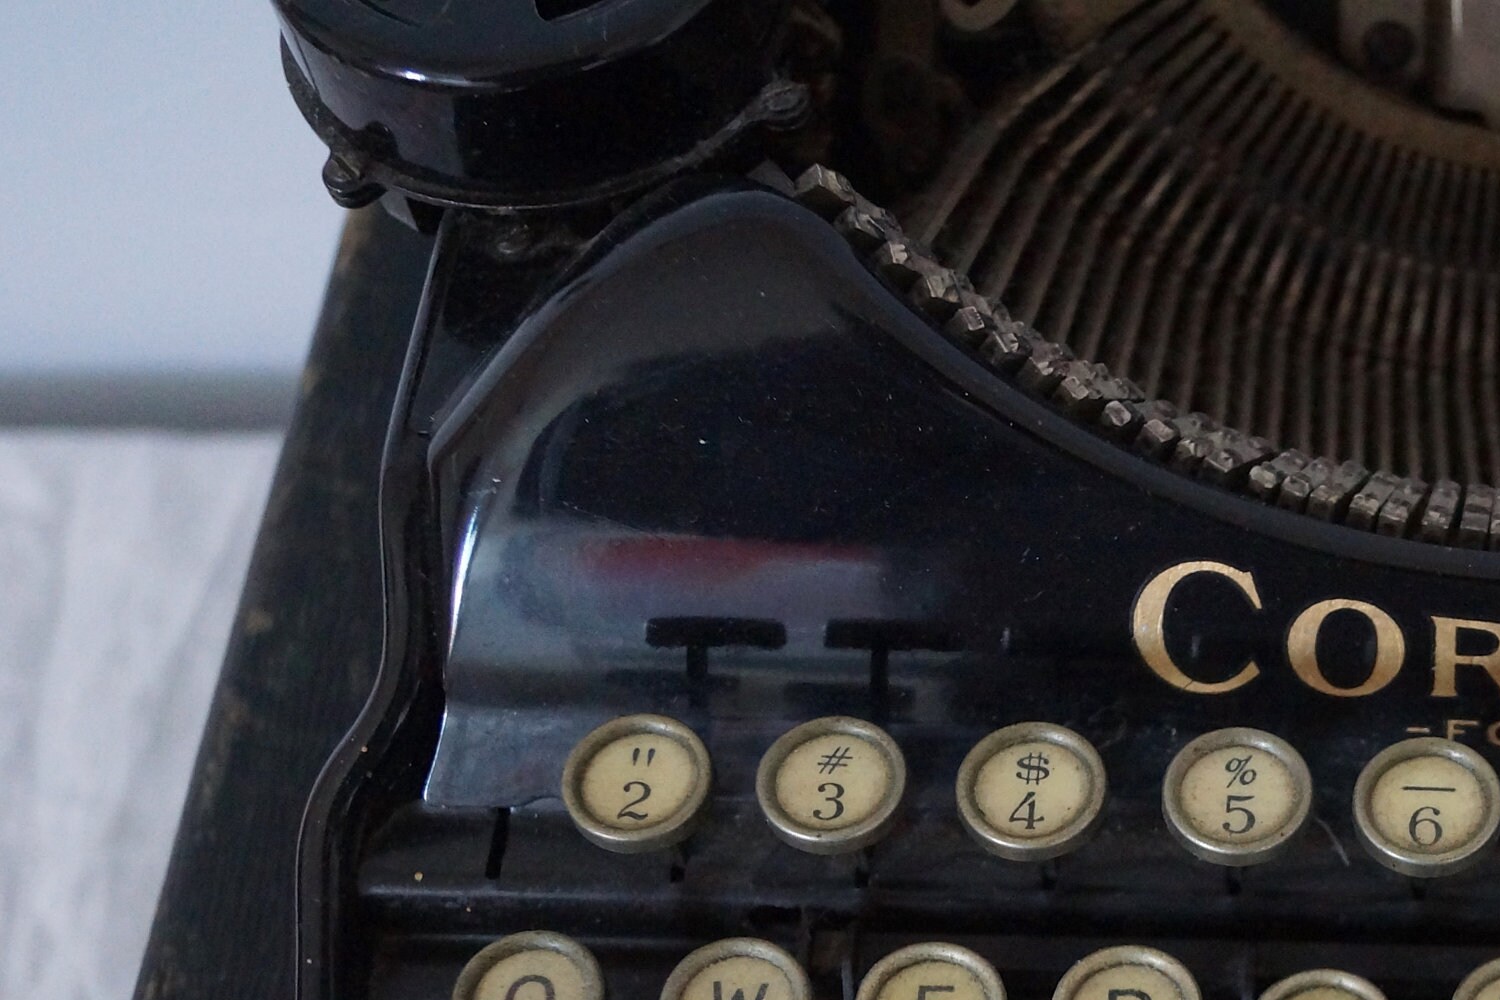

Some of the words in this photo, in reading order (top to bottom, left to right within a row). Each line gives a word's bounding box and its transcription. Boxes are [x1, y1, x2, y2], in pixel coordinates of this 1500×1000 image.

[817, 746, 853, 774] #
[1015, 751, 1050, 785] $
[1224, 754, 1257, 788] %
[616, 780, 652, 821] 2
[812, 782, 845, 821] 3
[1008, 791, 1045, 830] 4
[1222, 794, 1256, 836] 5
[1408, 806, 1443, 848] 6
